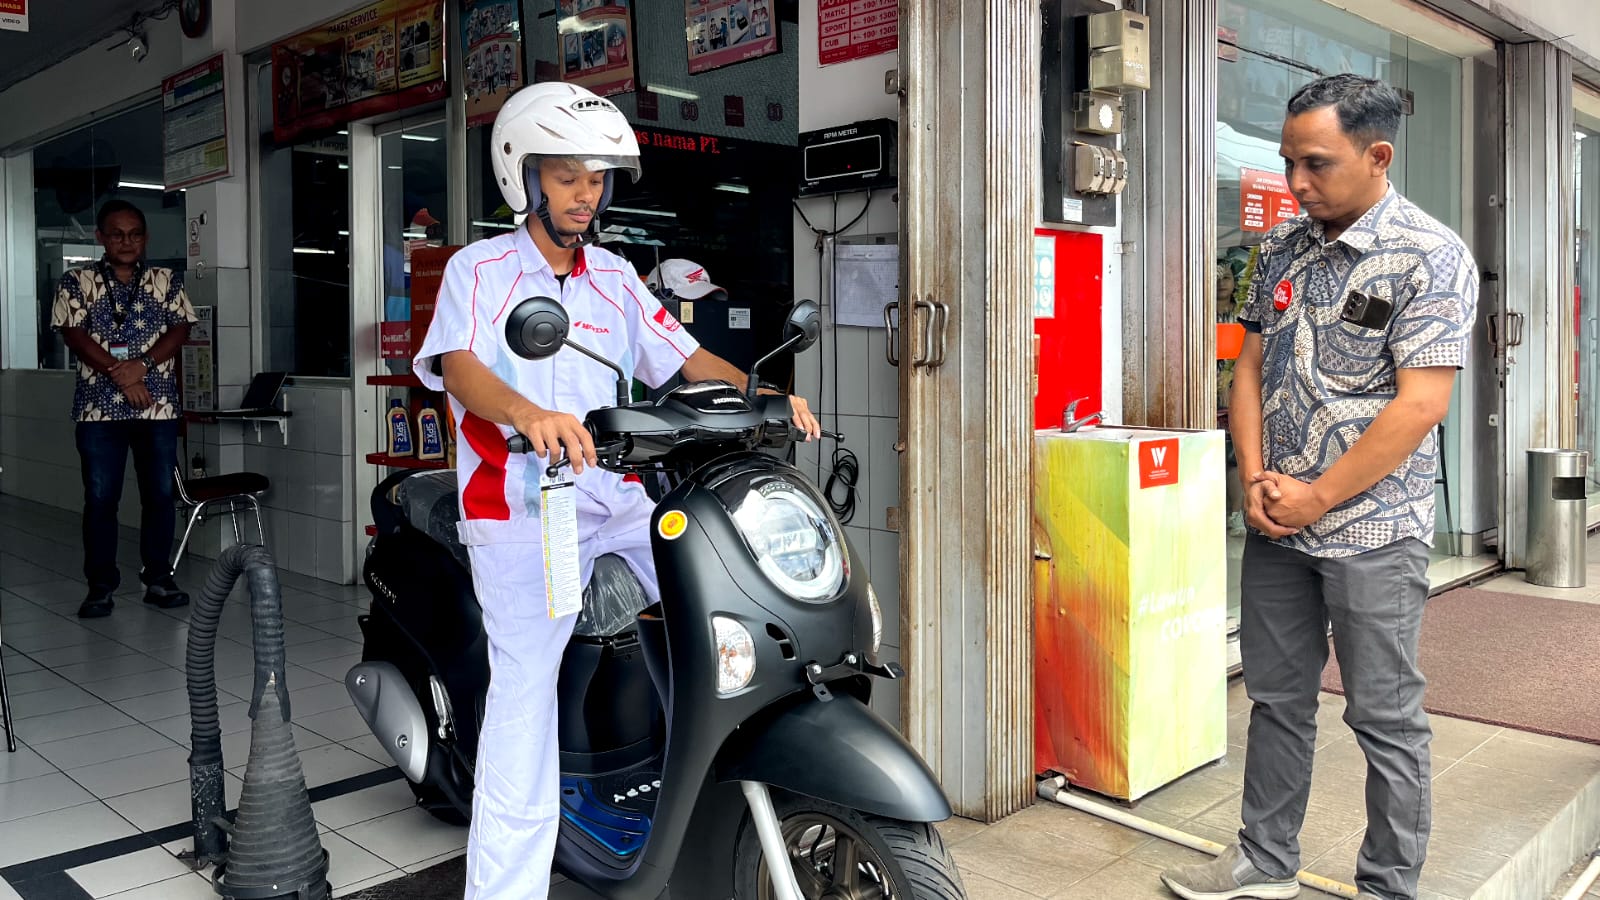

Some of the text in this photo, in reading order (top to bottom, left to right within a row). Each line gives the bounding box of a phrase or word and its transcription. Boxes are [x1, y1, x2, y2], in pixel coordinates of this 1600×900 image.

[824, 8, 846, 20] MATIC
[824, 22, 847, 33] SPORT
[824, 38, 839, 48] CUB
[823, 127, 858, 140] RPM METER
[652, 131, 696, 151] nama
[582, 322, 610, 334] HONDA
